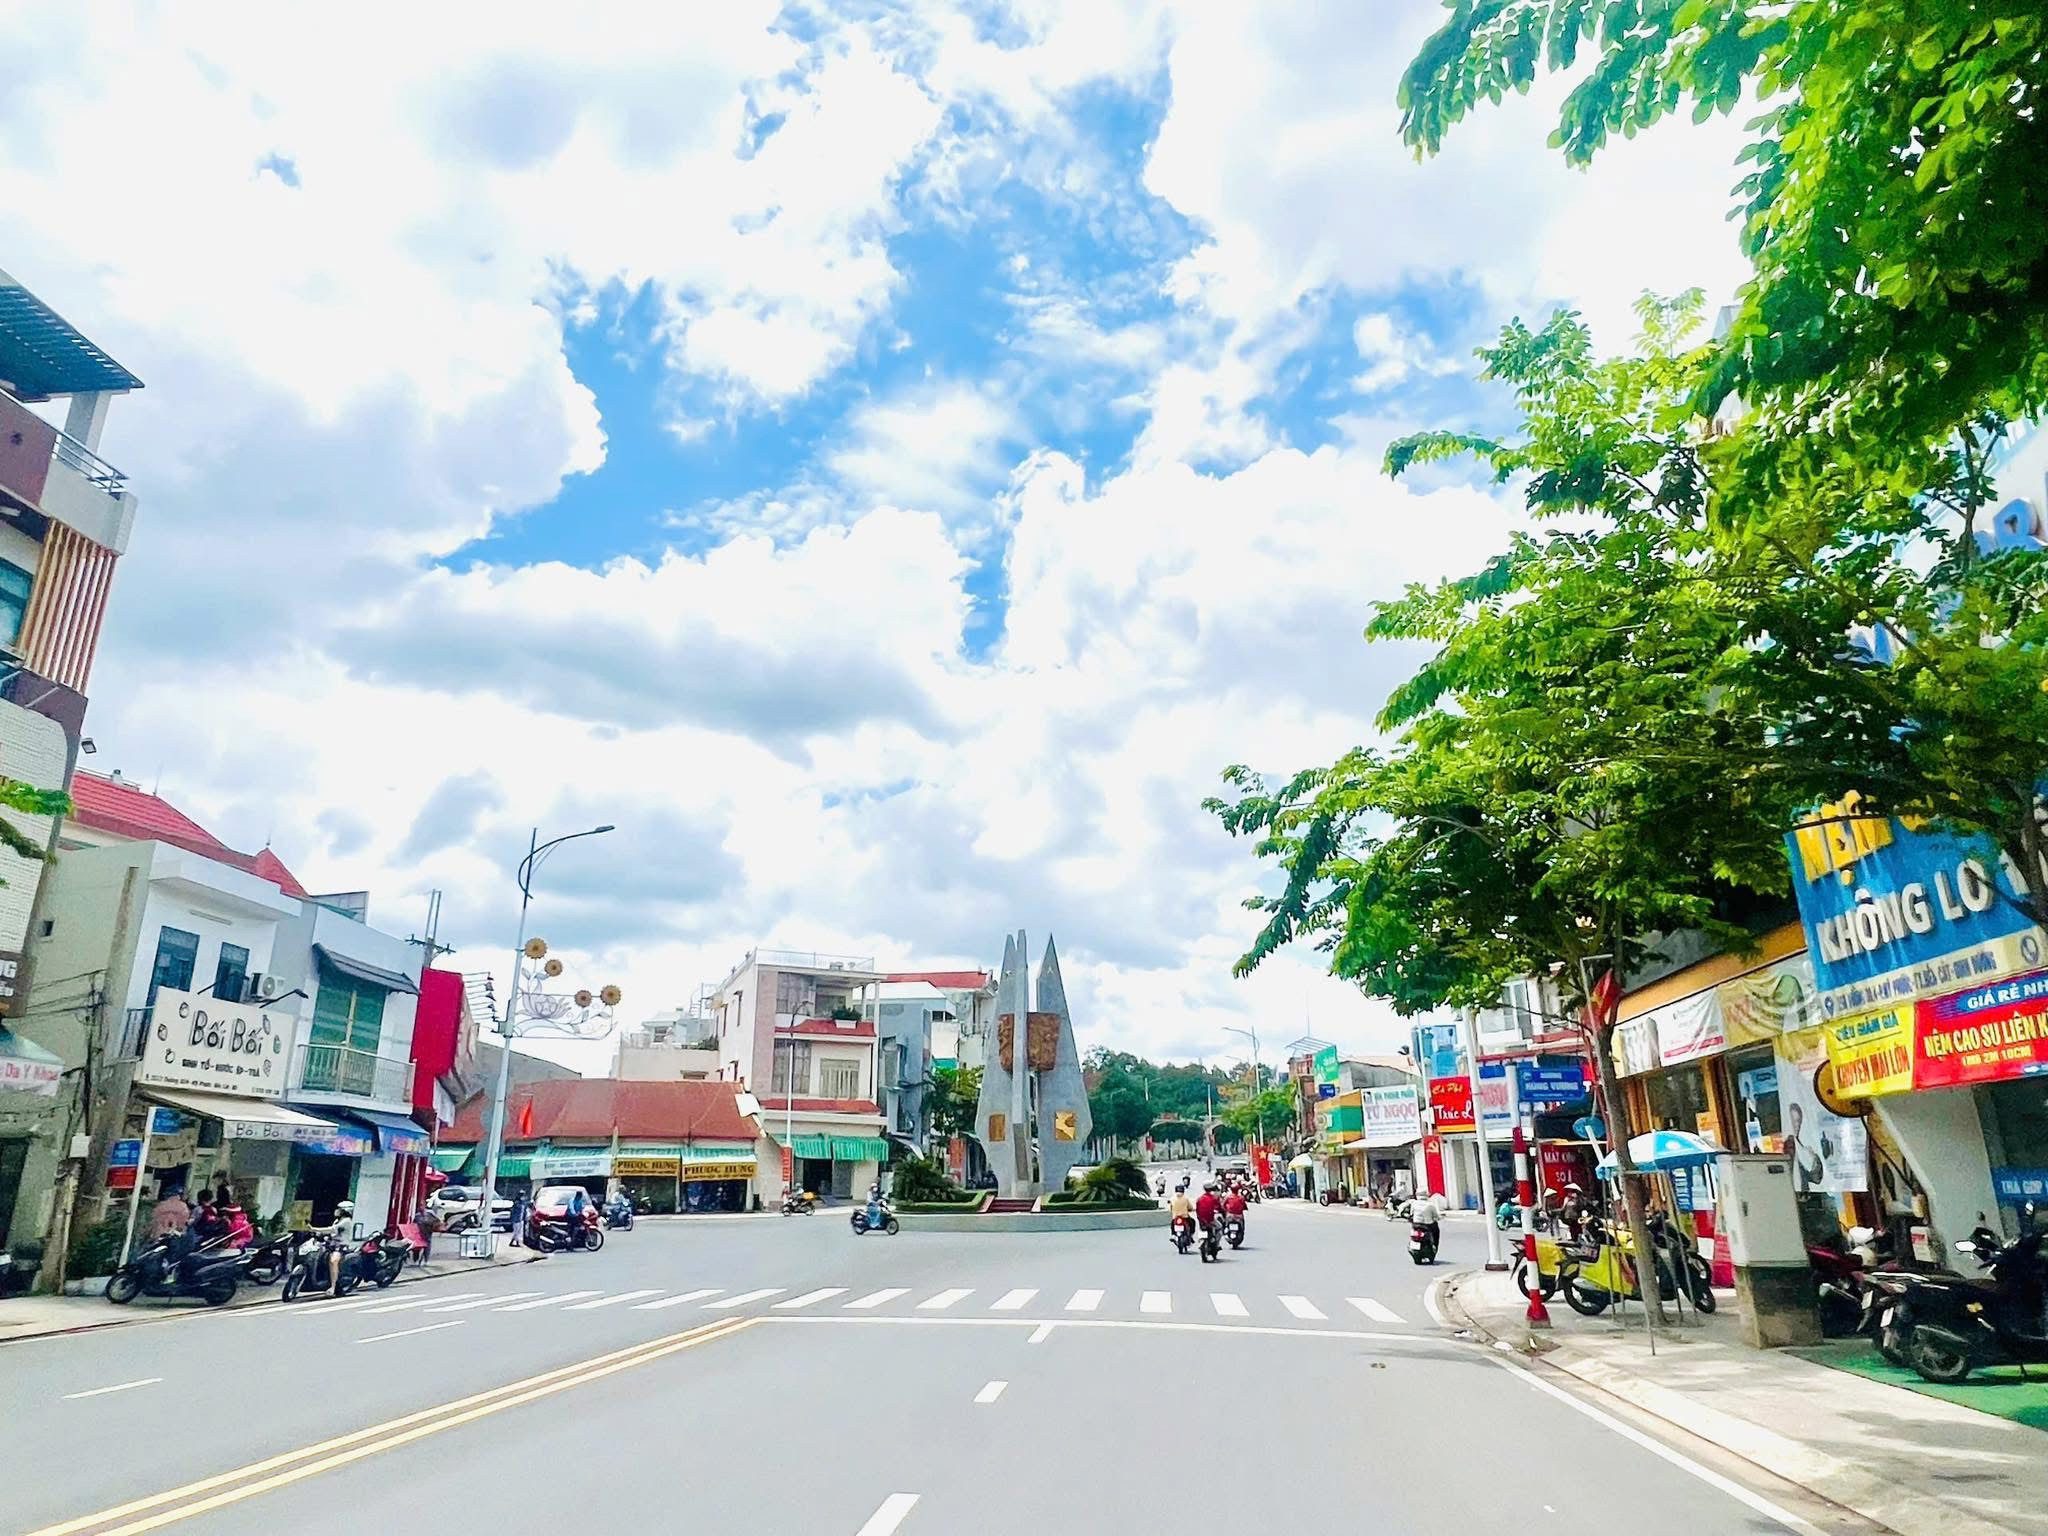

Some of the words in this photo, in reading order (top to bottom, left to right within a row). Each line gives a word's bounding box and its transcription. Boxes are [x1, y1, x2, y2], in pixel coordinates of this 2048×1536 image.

[1816, 882, 1935, 964] KHÔNG
[1967, 986, 1996, 1009] GIÁ
[1997, 982, 2021, 1003] RẺ
[188, 1009, 228, 1050] Bối
[229, 1016, 264, 1056] Bối
[1923, 1026, 1954, 1063] NỆM
[1953, 1026, 1981, 1053] CAO
[1980, 1021, 2002, 1047] SU
[2000, 1009, 2038, 1045] LIÊN
